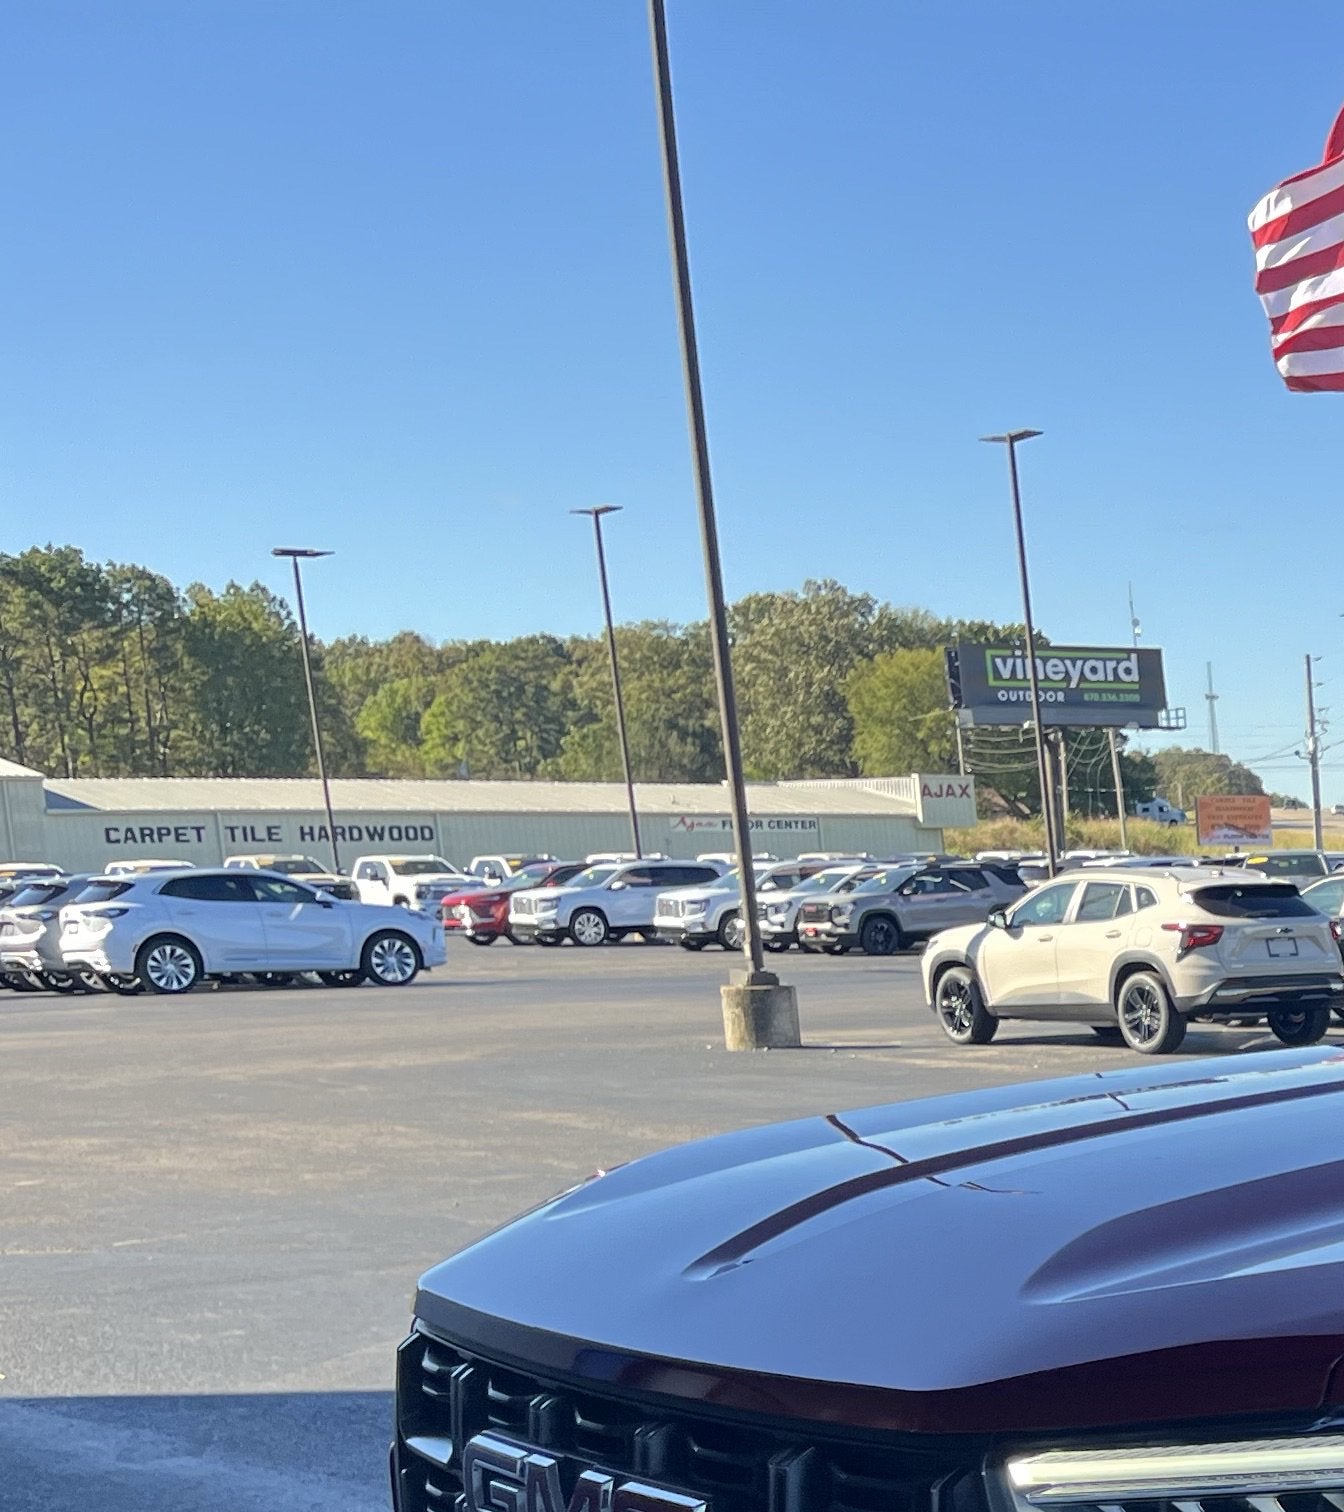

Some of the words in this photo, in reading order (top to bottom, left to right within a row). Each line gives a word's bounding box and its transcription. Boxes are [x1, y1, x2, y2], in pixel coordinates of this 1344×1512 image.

[994, 650, 1140, 689] vineyard
[921, 783, 971, 799] AJAX
[767, 819, 817, 830] CENTER
[104, 825, 206, 844] CARPET
[224, 825, 283, 843] TILE
[300, 825, 434, 842] HARDWOOD
